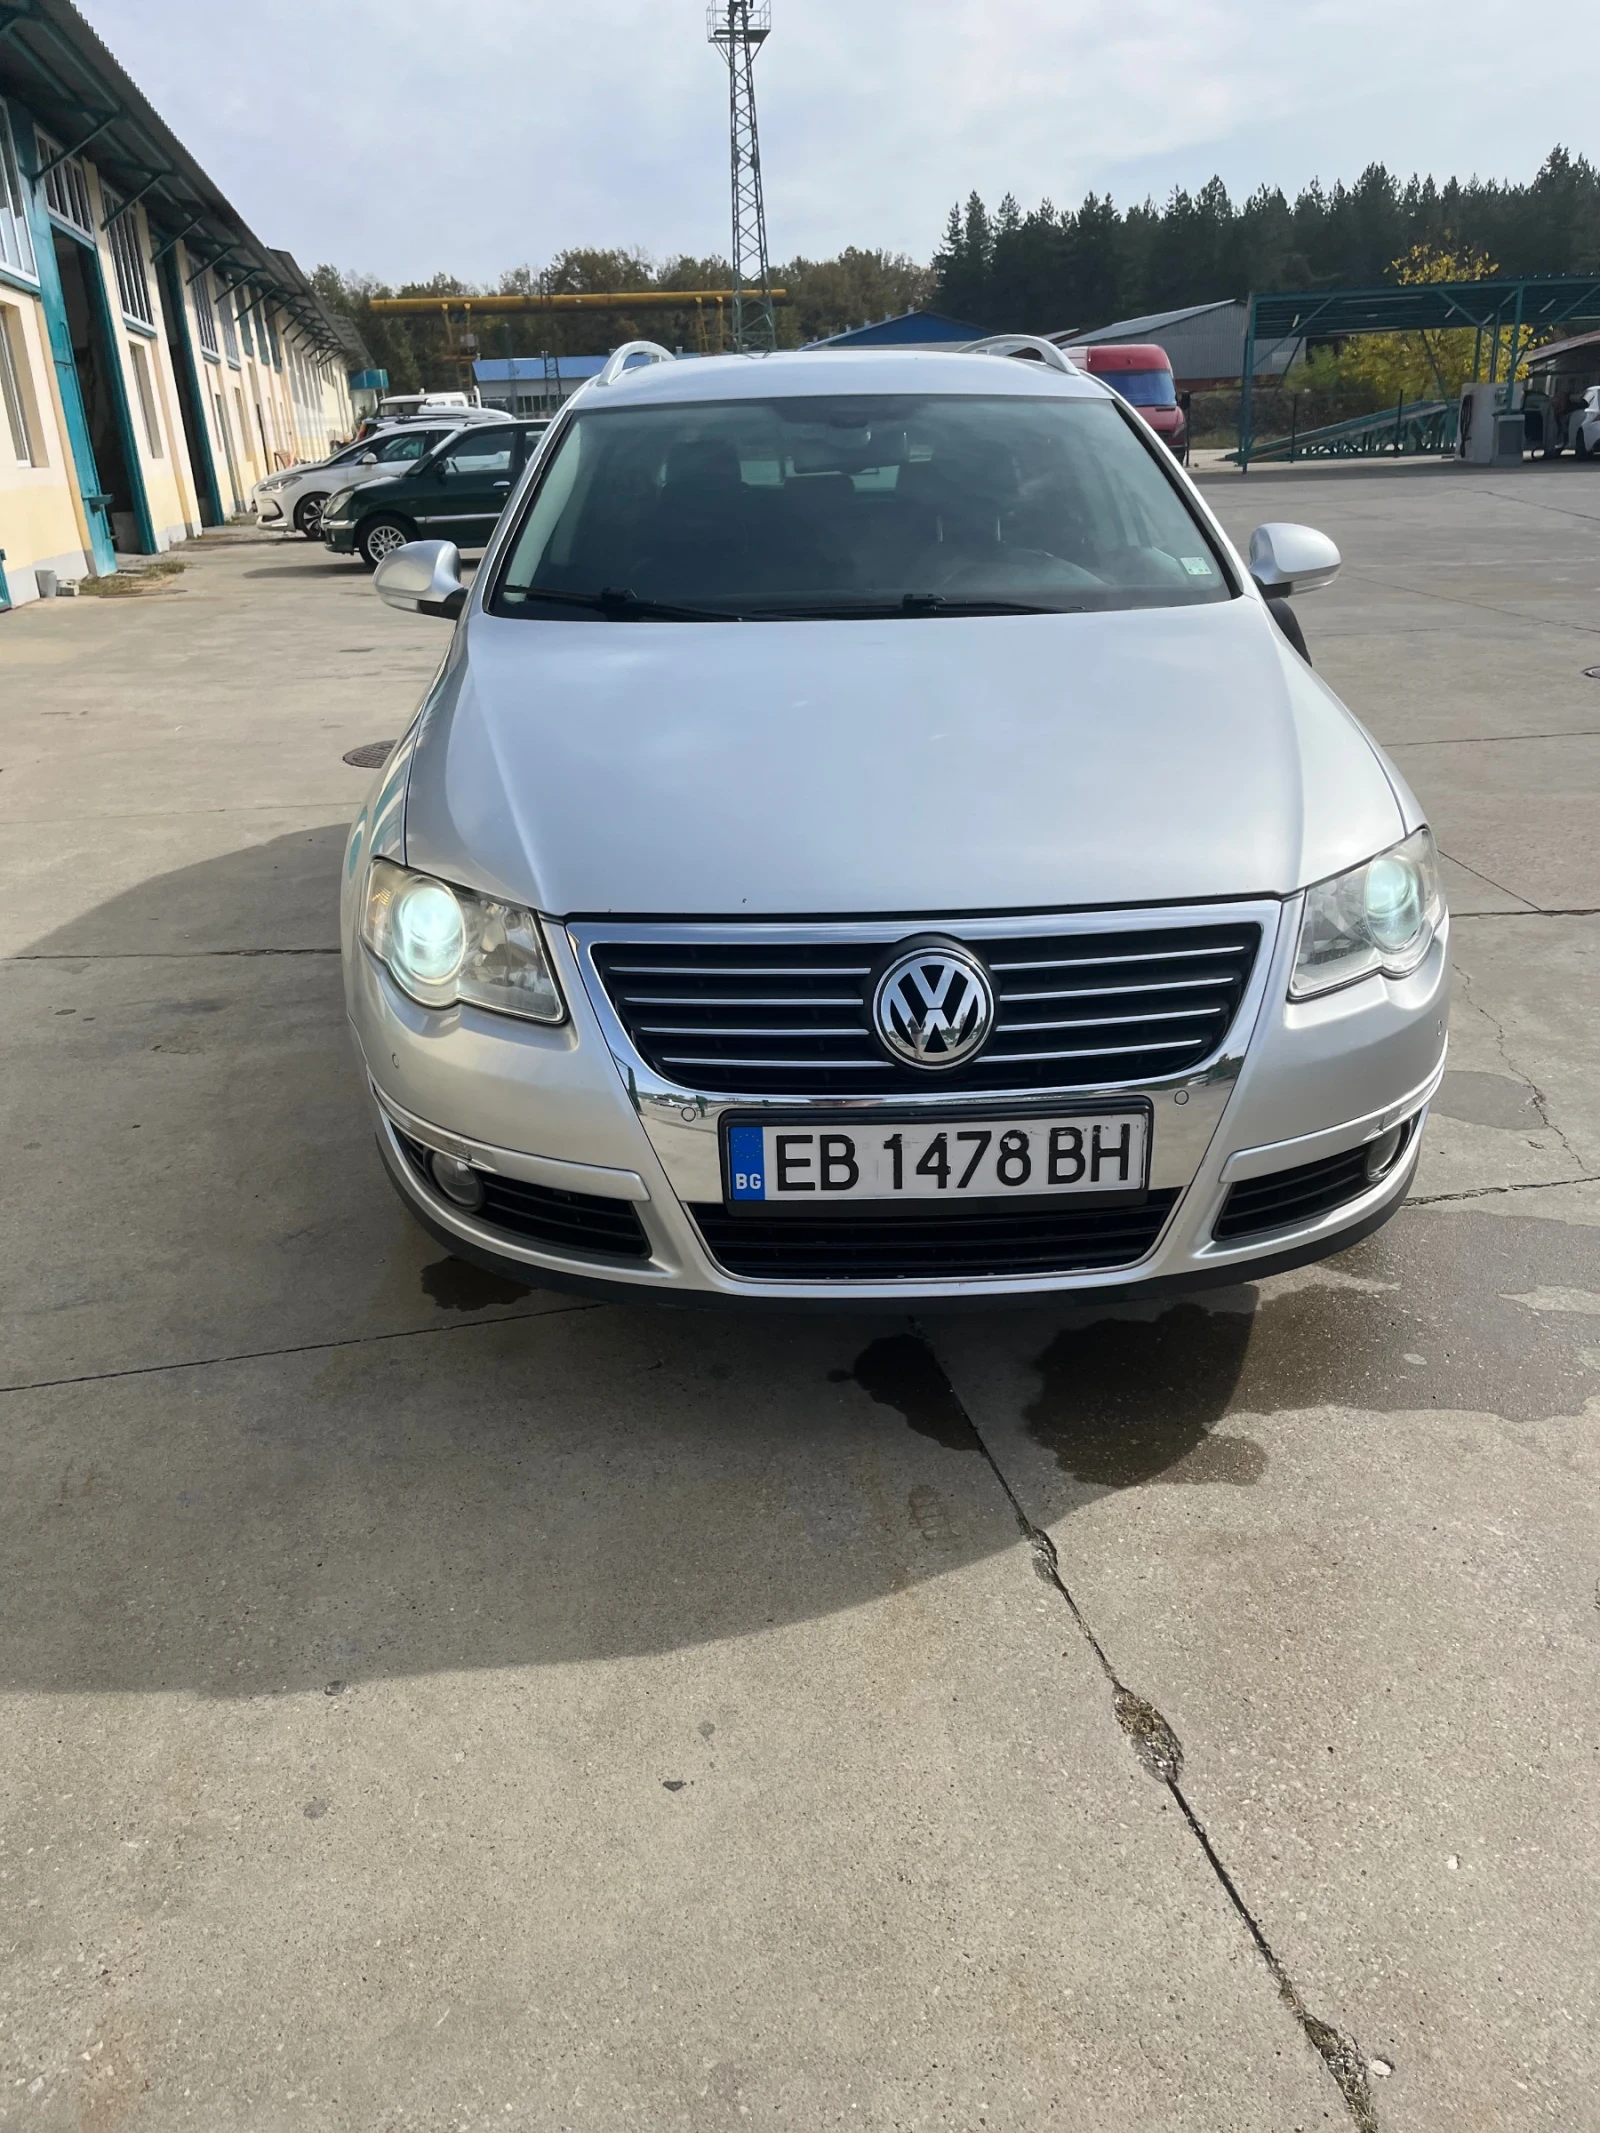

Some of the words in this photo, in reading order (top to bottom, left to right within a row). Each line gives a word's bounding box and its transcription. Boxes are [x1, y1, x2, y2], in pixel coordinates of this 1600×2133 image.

[880, 955, 987, 1062] VW
[735, 1173, 762, 1190] BG
[775, 1133, 860, 1192] EB
[882, 1130, 1033, 1190] 1478
[1046, 1123, 1131, 1185] BH
